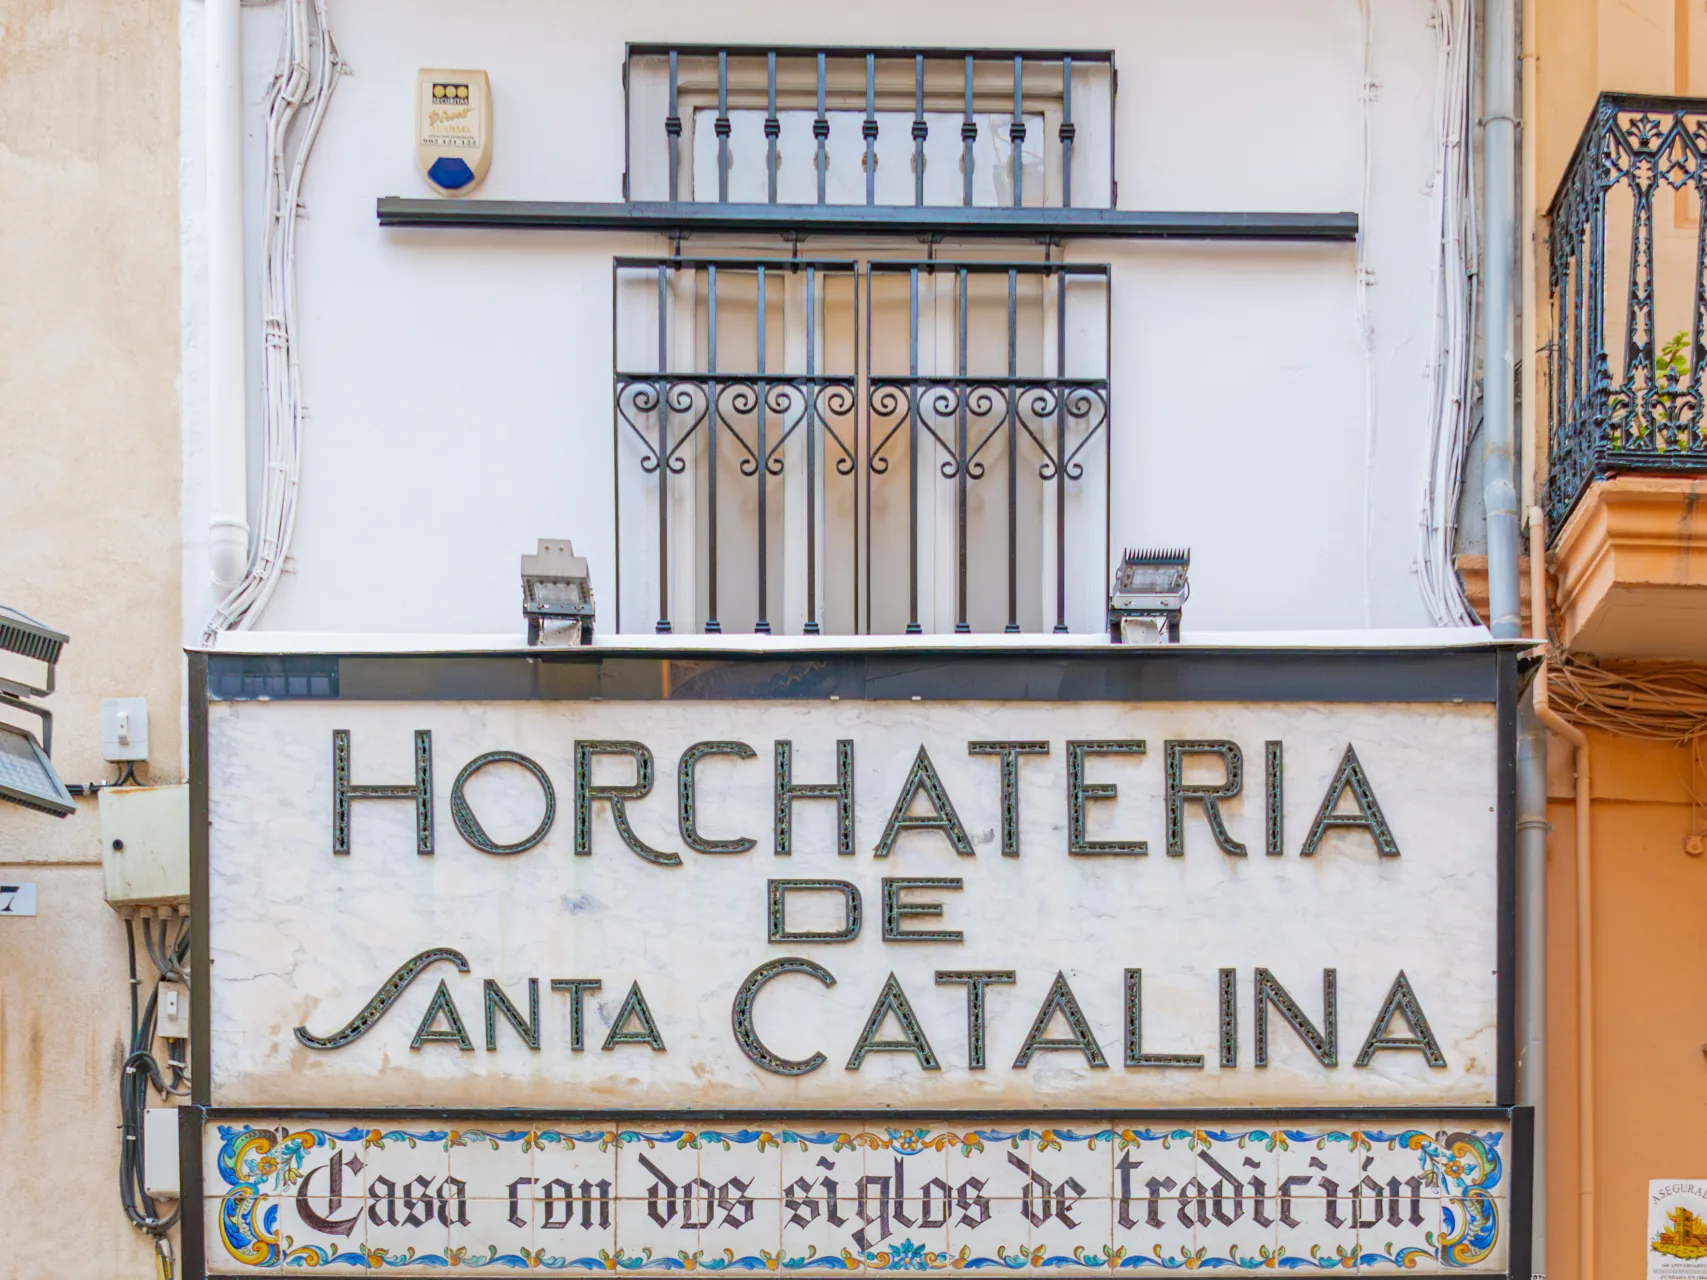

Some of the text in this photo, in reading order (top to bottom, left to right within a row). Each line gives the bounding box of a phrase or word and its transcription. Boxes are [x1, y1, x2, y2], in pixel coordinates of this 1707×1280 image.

[333, 729, 1400, 865] HORCHATERIA
[768, 877, 963, 943] DE
[293, 948, 1447, 1076] SANTA CATALINA
[296, 1151, 470, 1236] Casa
[506, 1176, 612, 1230] con
[638, 1153, 754, 1230] dos
[783, 1156, 992, 1252] siglos
[1007, 1150, 1088, 1229] de
